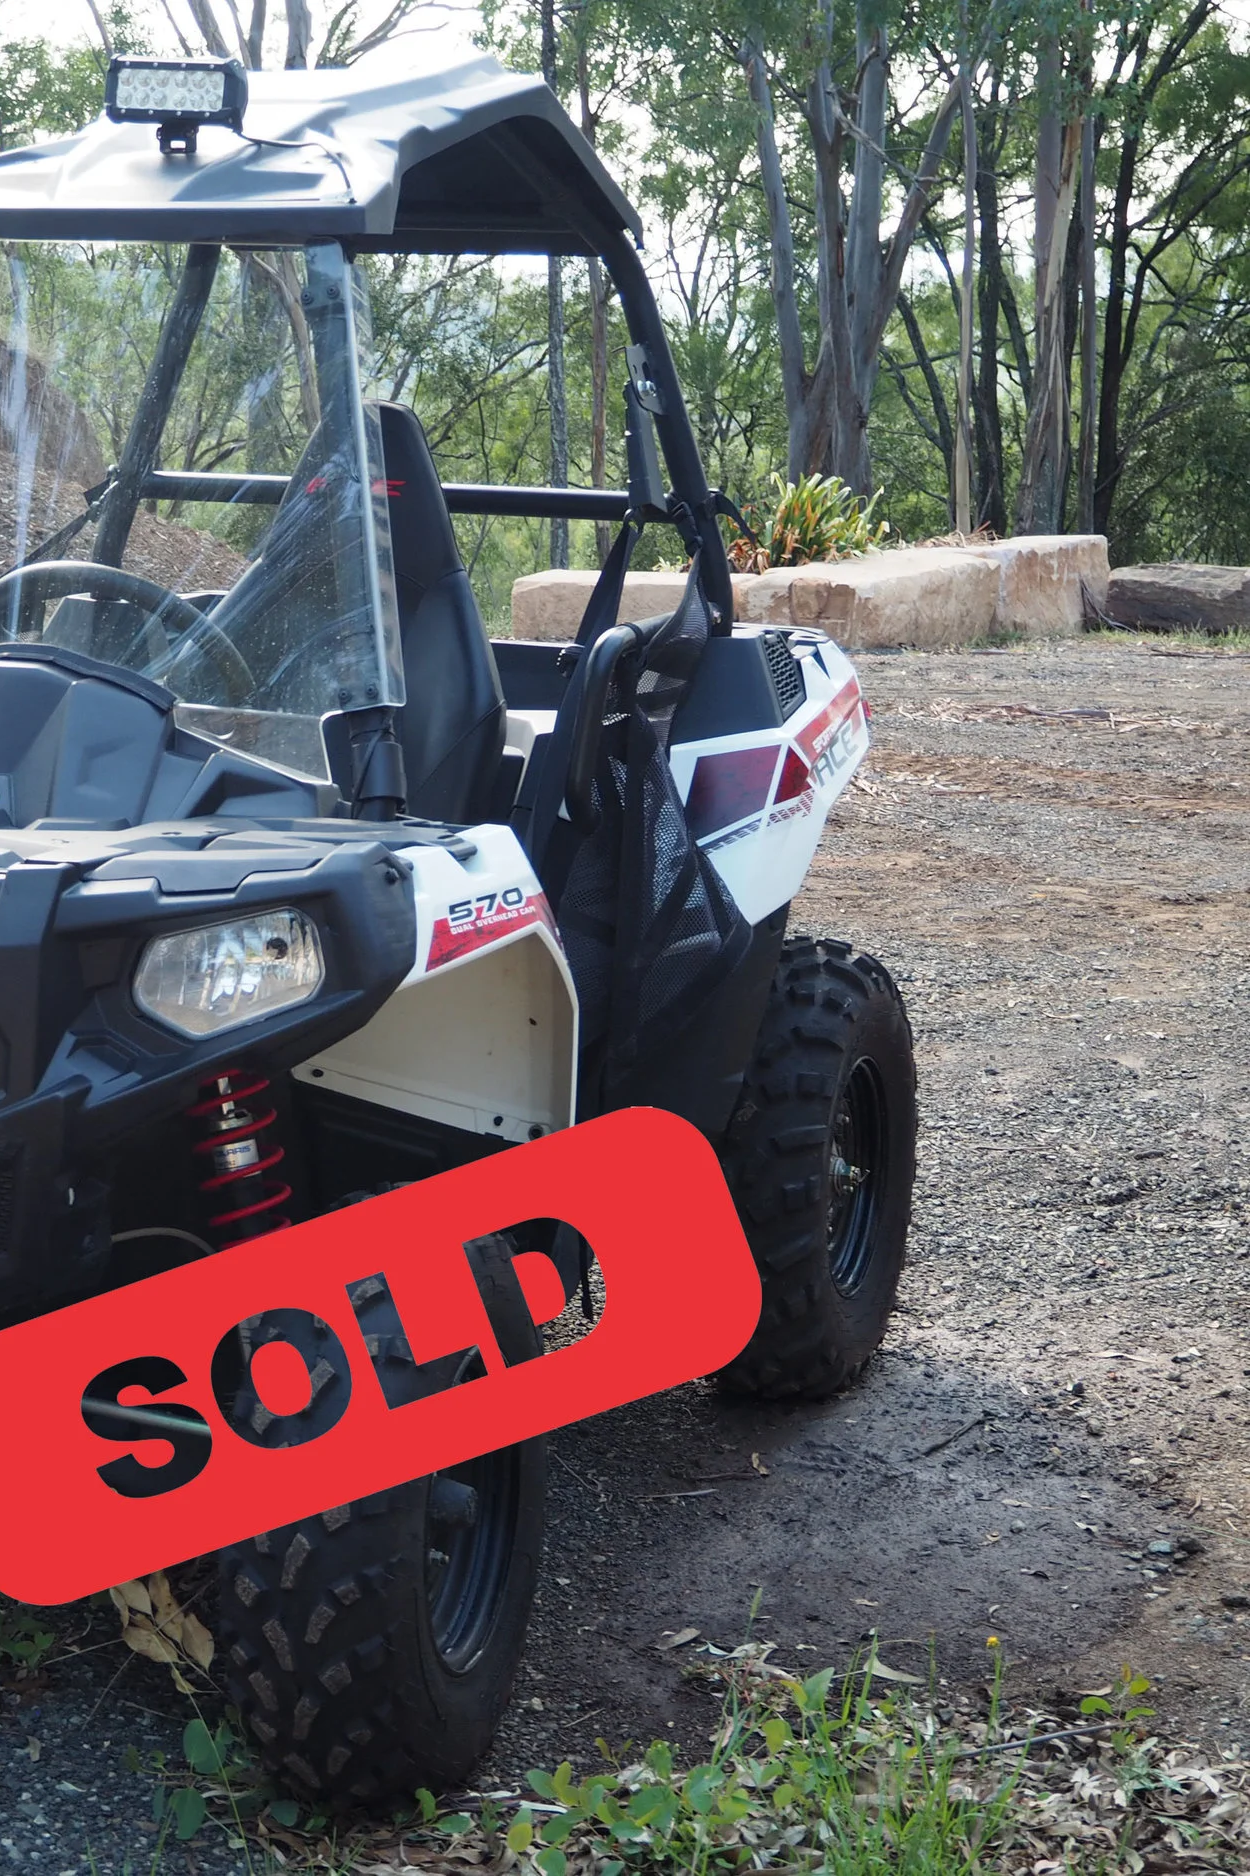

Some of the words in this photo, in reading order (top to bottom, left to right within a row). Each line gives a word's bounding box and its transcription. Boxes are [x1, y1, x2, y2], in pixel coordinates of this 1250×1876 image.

[814, 722, 859, 788] ACE
[448, 887, 524, 923] 570
[450, 924, 474, 935] DUAL
